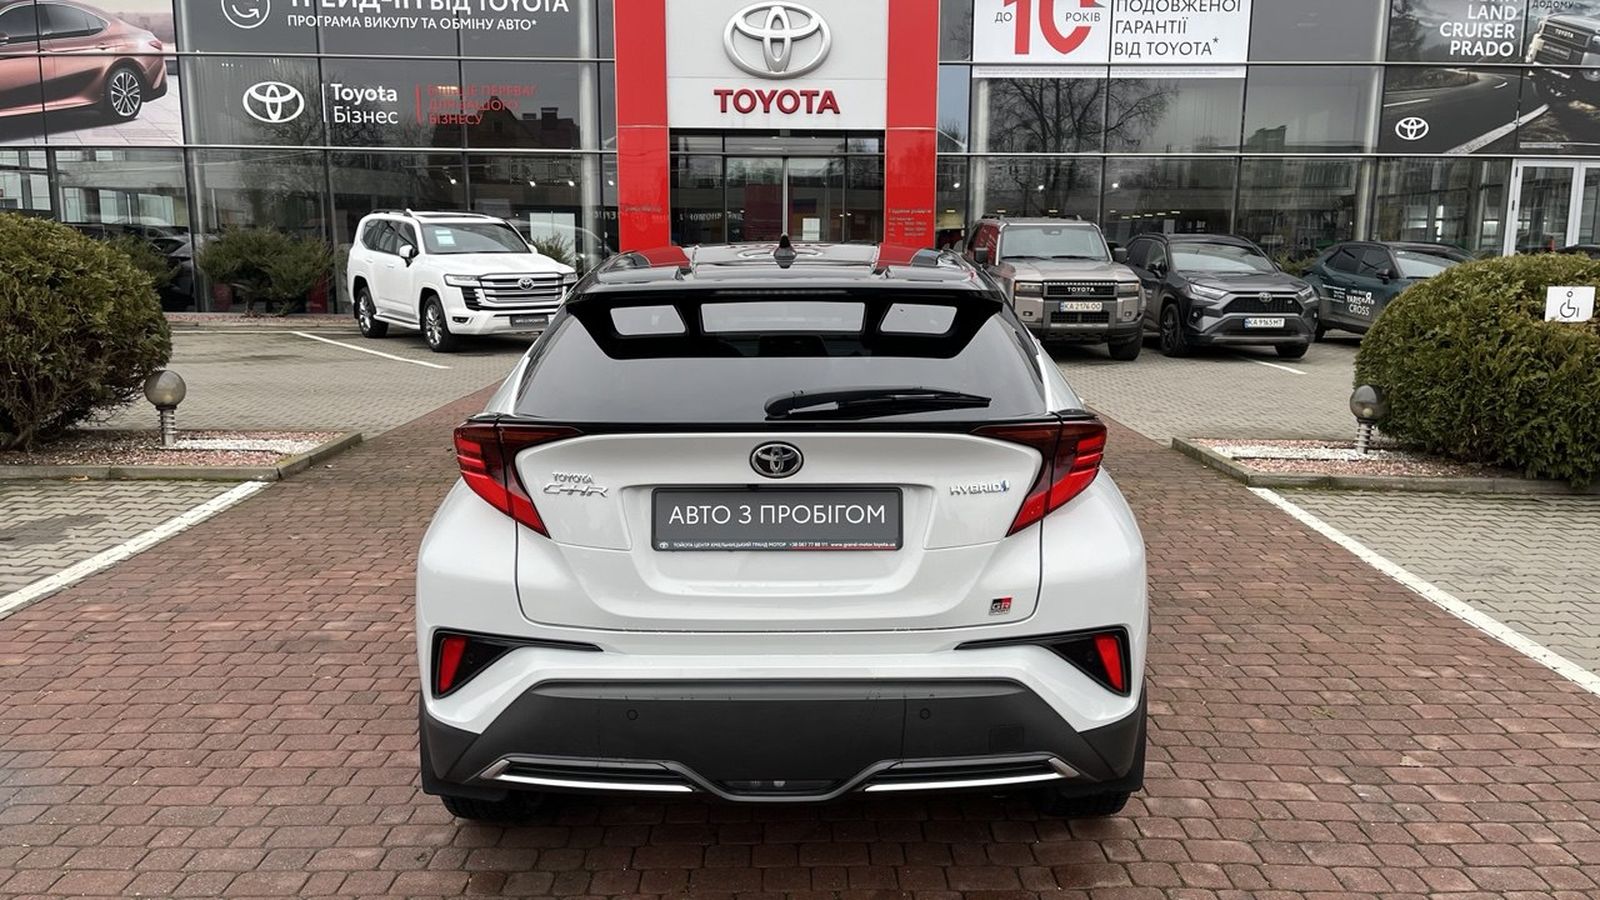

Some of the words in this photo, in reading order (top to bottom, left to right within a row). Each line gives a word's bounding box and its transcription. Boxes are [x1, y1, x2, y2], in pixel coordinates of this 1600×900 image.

[995, 12, 1013, 23] ДО
[1065, 12, 1101, 22] РОКІВ
[1467, 4, 1517, 21] LAND
[287, 15, 362, 28] ПРОГРАМА
[364, 16, 418, 29] ВИКУПУ
[421, 17, 437, 29] ТА
[440, 17, 494, 30] ОБМІНУ
[1115, 16, 1189, 34] ГАРАНТІЇ
[1439, 22, 1515, 39] CRUISER
[1114, 41, 1142, 58] ВІД
[1450, 40, 1514, 57] PRADO
[330, 83, 398, 105] Toyota
[713, 89, 840, 115] TOYOTA
[334, 106, 398, 124] Бізнес
[552, 472, 594, 484] TOYOTA
[543, 483, 608, 498] C-HR
[949, 484, 1001, 496] HYBRID
[668, 505, 731, 525] АВТО
[738, 505, 752, 525] З
[760, 505, 886, 525] ПРОБІГОМ
